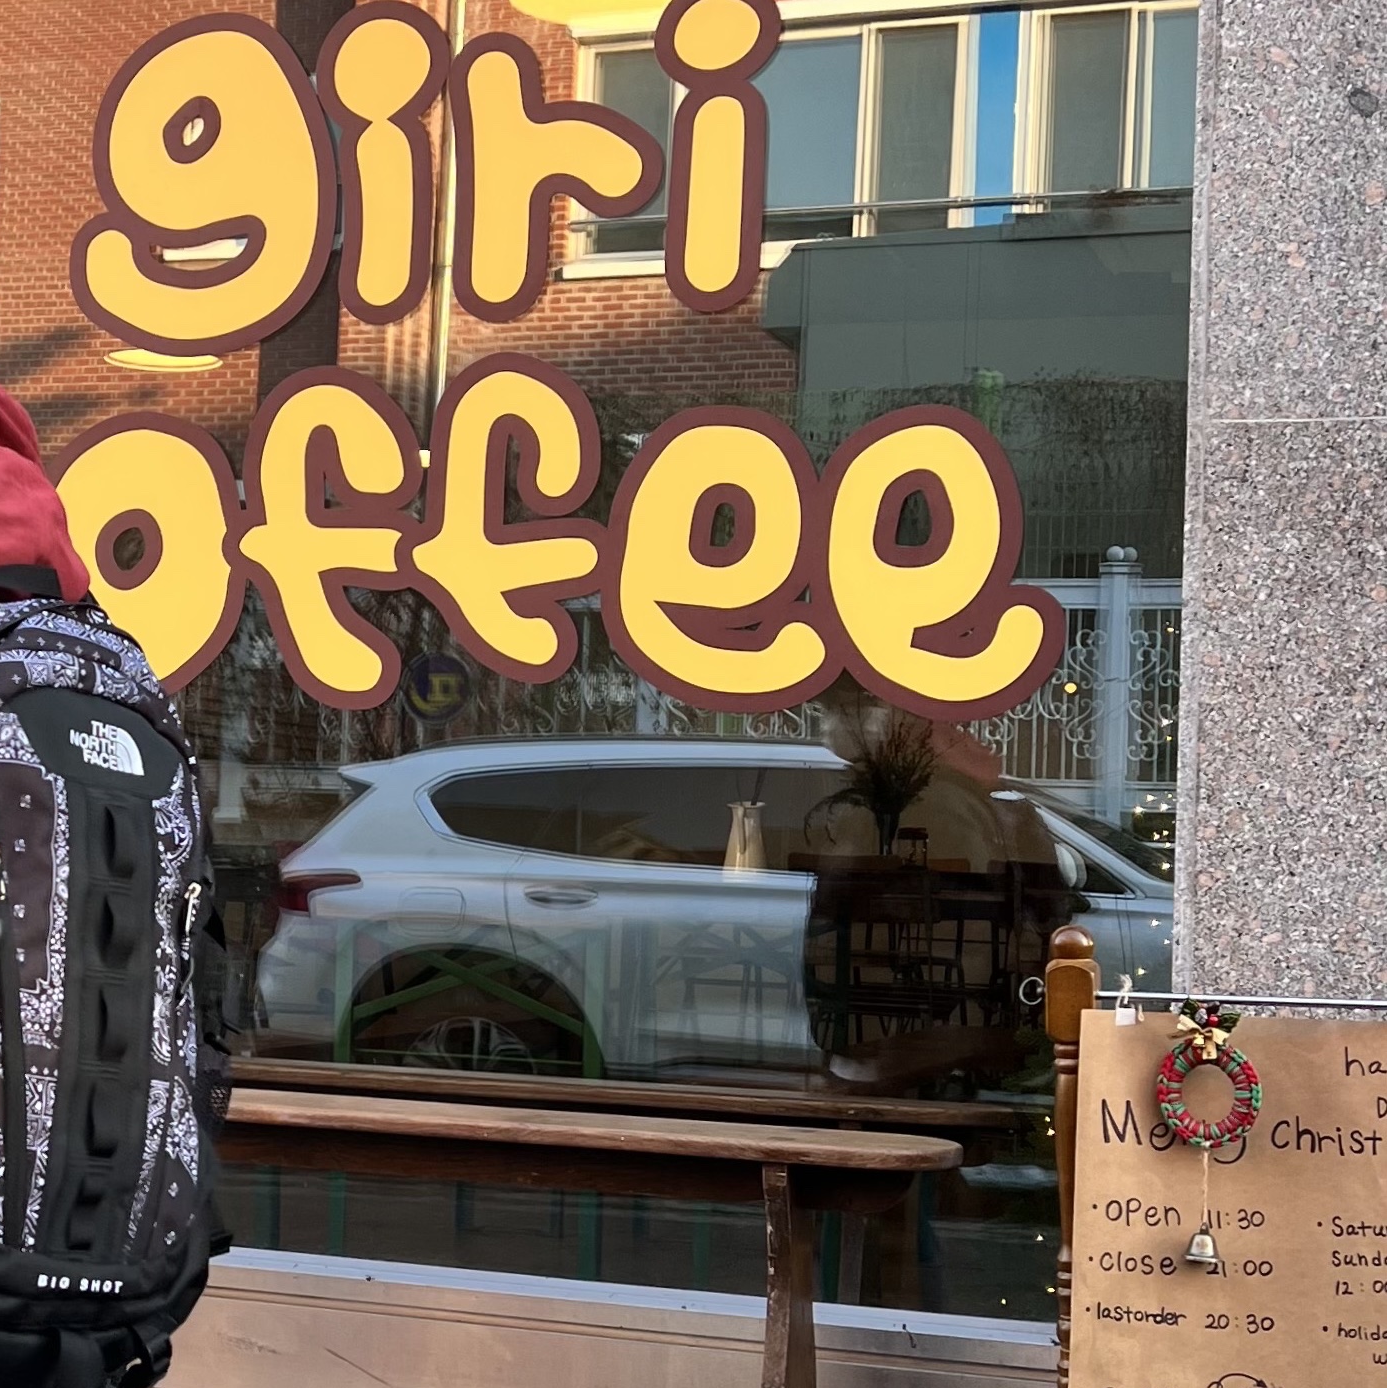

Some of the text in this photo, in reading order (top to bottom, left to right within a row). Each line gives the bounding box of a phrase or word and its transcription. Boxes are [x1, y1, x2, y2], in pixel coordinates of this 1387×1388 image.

[73, 0, 778, 354] giri
[50, 353, 1065, 720] offee
[90, 719, 117, 739] THE
[69, 729, 116, 755] NORTH
[83, 750, 119, 770] FACE
[1271, 1115, 1383, 1157] Christ
[1331, 1215, 1387, 1237] Satu
[1331, 1250, 1387, 1267] Sund
[37, 1274, 124, 1294] BIG SHOT
[1335, 1280, 1387, 1296] 12:0
[1204, 1313, 1275, 1334] 20:30
